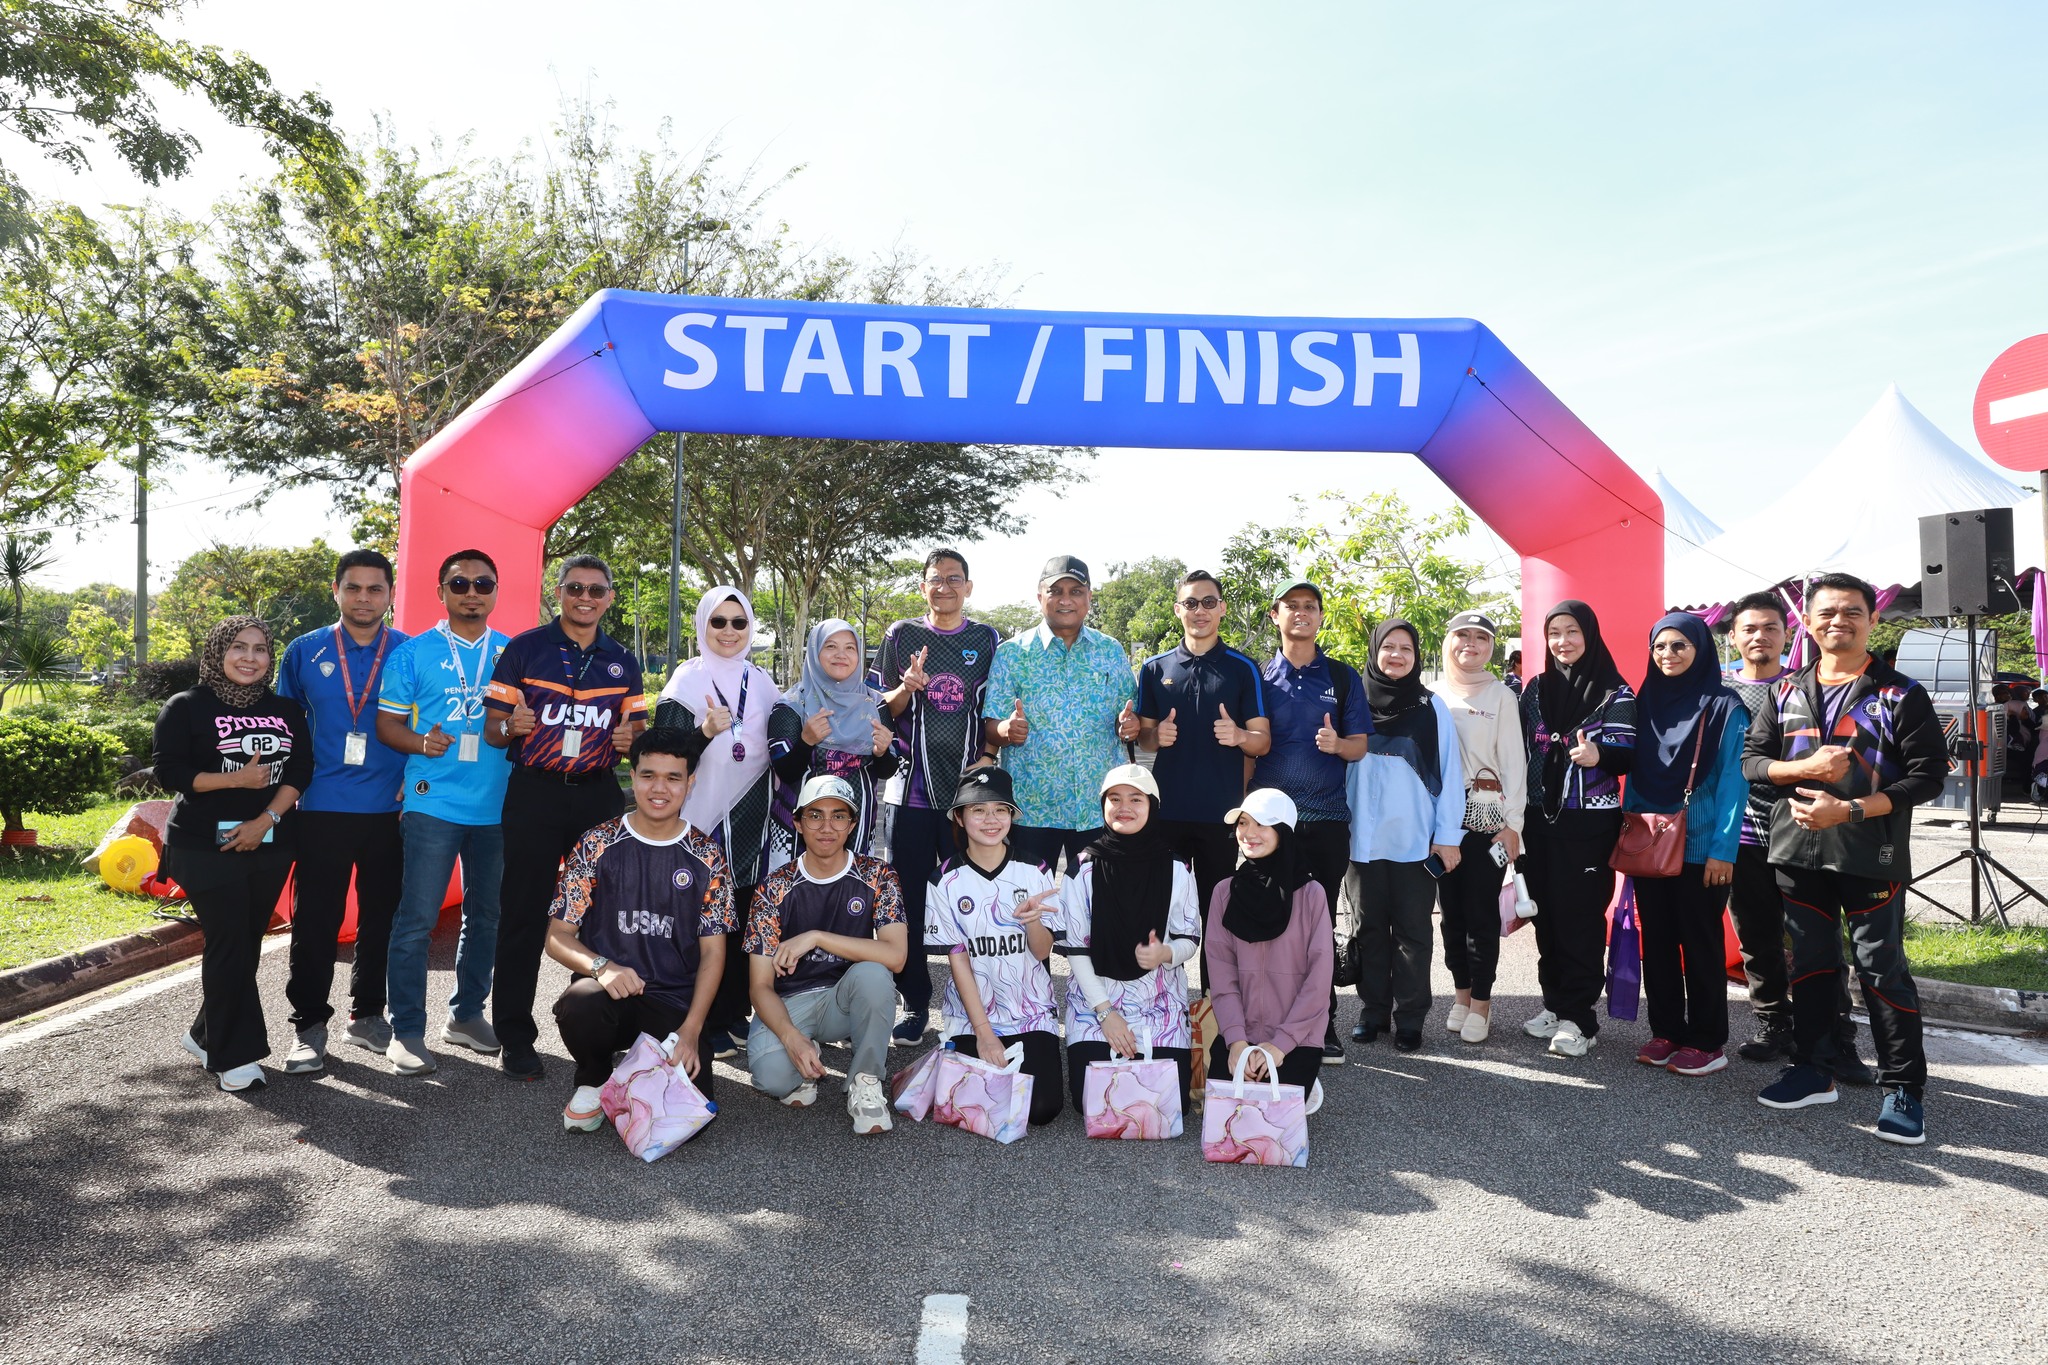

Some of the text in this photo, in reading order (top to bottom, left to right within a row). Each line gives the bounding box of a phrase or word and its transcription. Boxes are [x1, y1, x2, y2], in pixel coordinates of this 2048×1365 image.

[663, 312, 1421, 407] START / FINISH
[928, 691, 943, 700] FUN
[215, 716, 294, 738] STORM
[541, 703, 612, 730] USM
[252, 737, 273, 752] 82
[827, 761, 843, 771] FUN
[617, 910, 675, 939] USM
